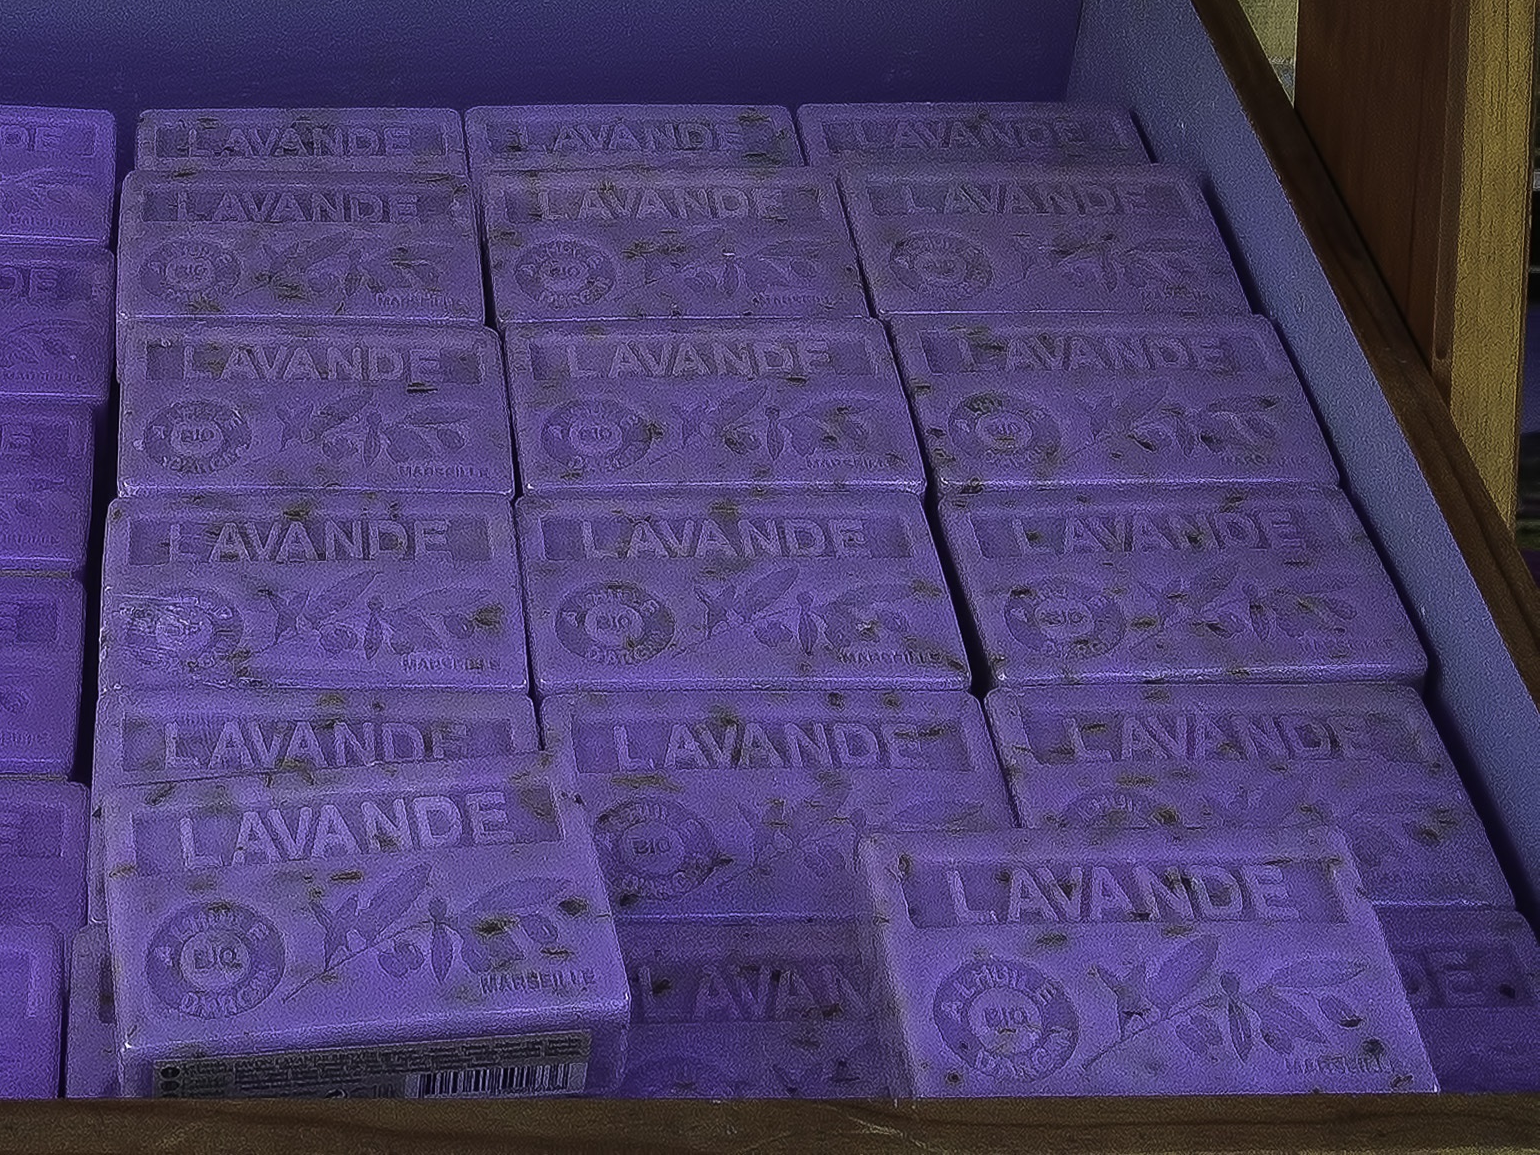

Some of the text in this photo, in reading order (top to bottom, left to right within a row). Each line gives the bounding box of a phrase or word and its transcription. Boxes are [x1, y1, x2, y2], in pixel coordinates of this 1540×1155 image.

[187, 126, 410, 157] LAVANDE
[176, 190, 417, 223] LAVANDE
[539, 185, 779, 220] LAVANDE
[182, 342, 442, 381] LAVANDE
[567, 337, 832, 378] LAVANDE
[169, 519, 450, 563] LAVANDE
[582, 516, 865, 558] LAVANDE
[163, 718, 467, 769] LAVANDE
[614, 719, 924, 770] LAVANDE
[1068, 710, 1381, 762] LAVANDE
[179, 790, 517, 870] LAVANDE
[948, 864, 1305, 924] LAVANDE
